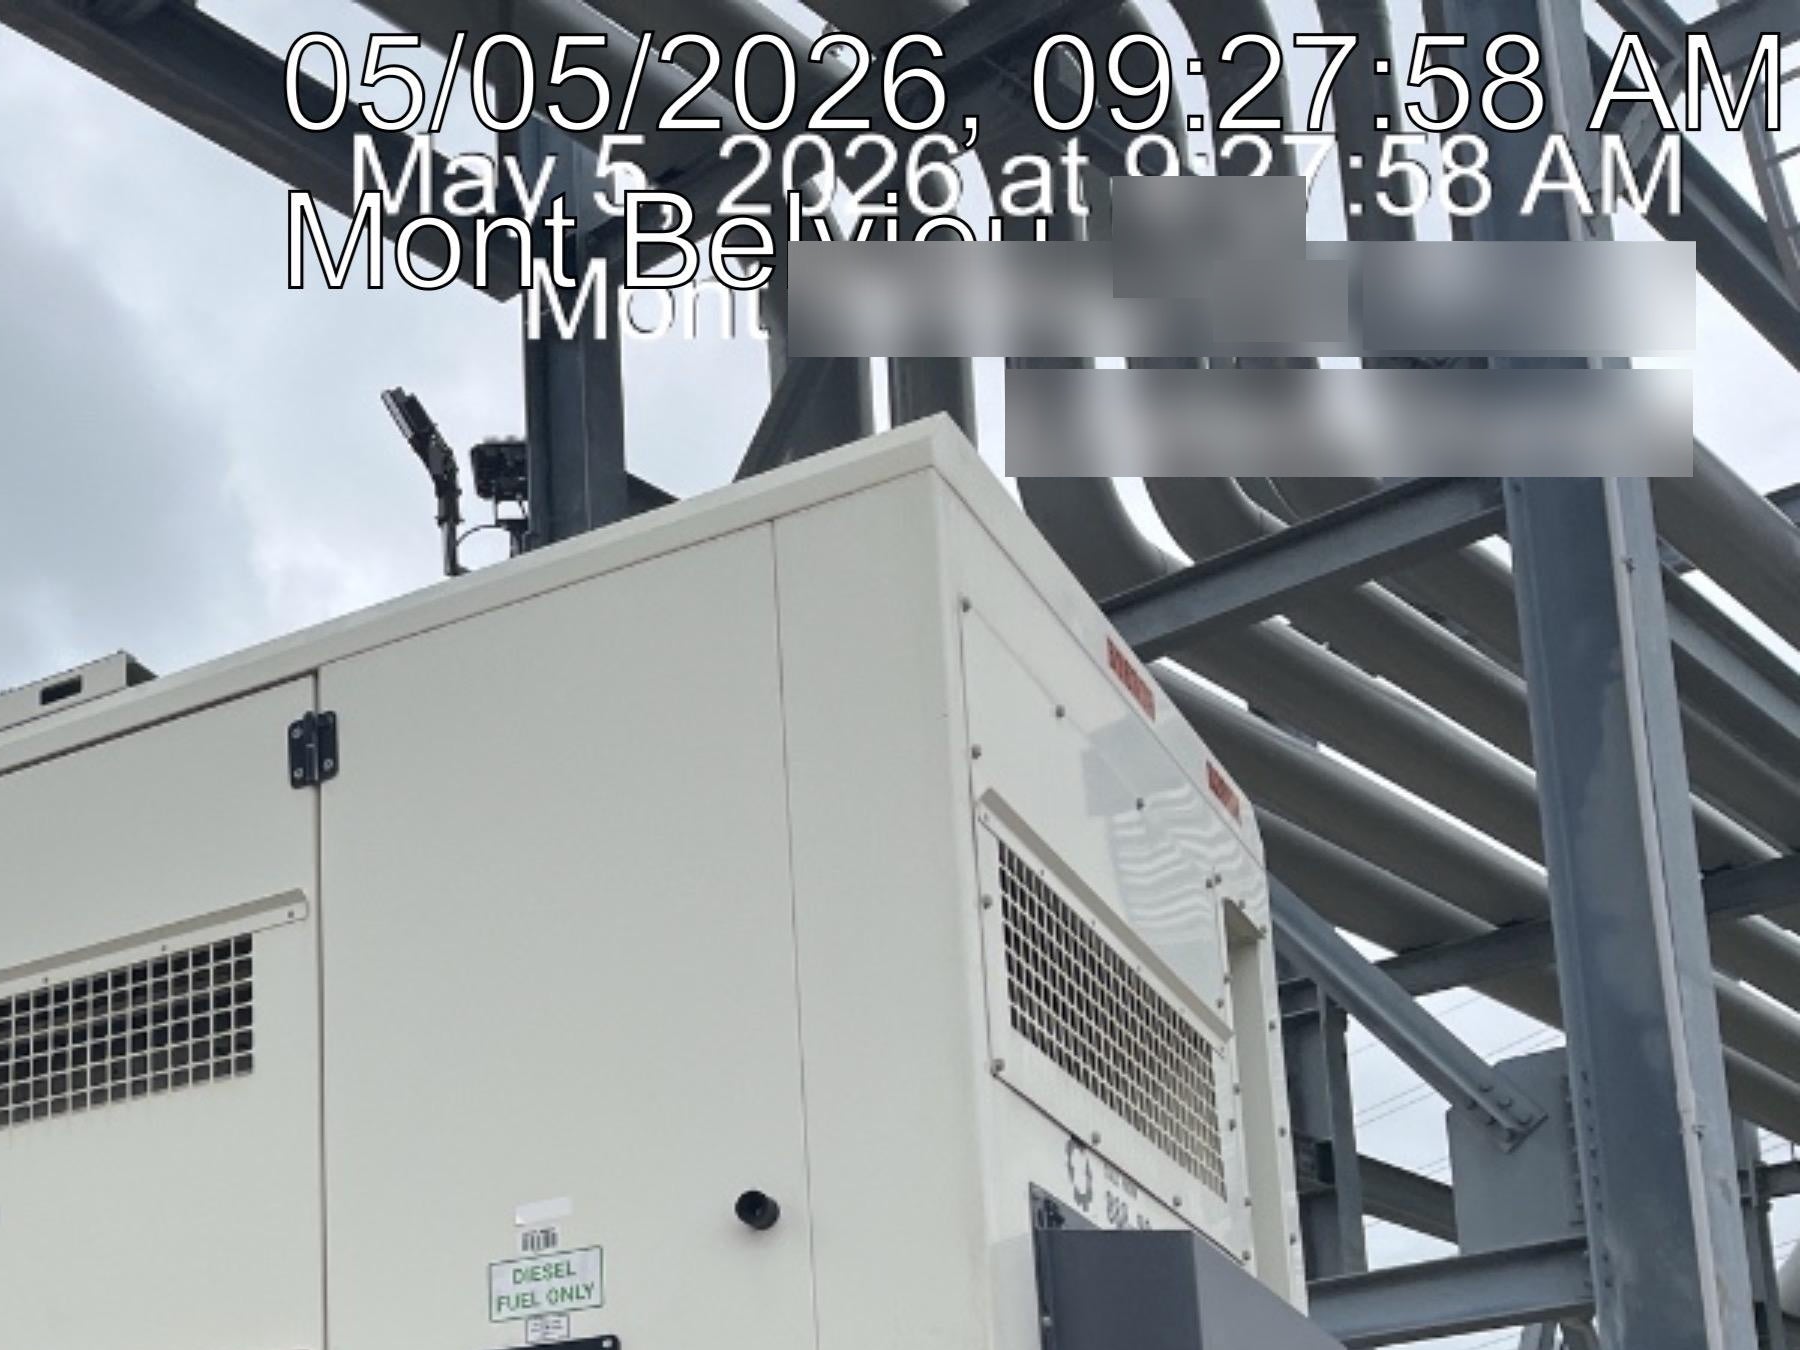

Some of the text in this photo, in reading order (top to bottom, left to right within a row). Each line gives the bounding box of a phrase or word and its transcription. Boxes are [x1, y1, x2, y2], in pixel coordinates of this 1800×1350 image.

[512, 1260, 576, 1285] DIESEL
[496, 1280, 595, 1313] FUEL ONLY
